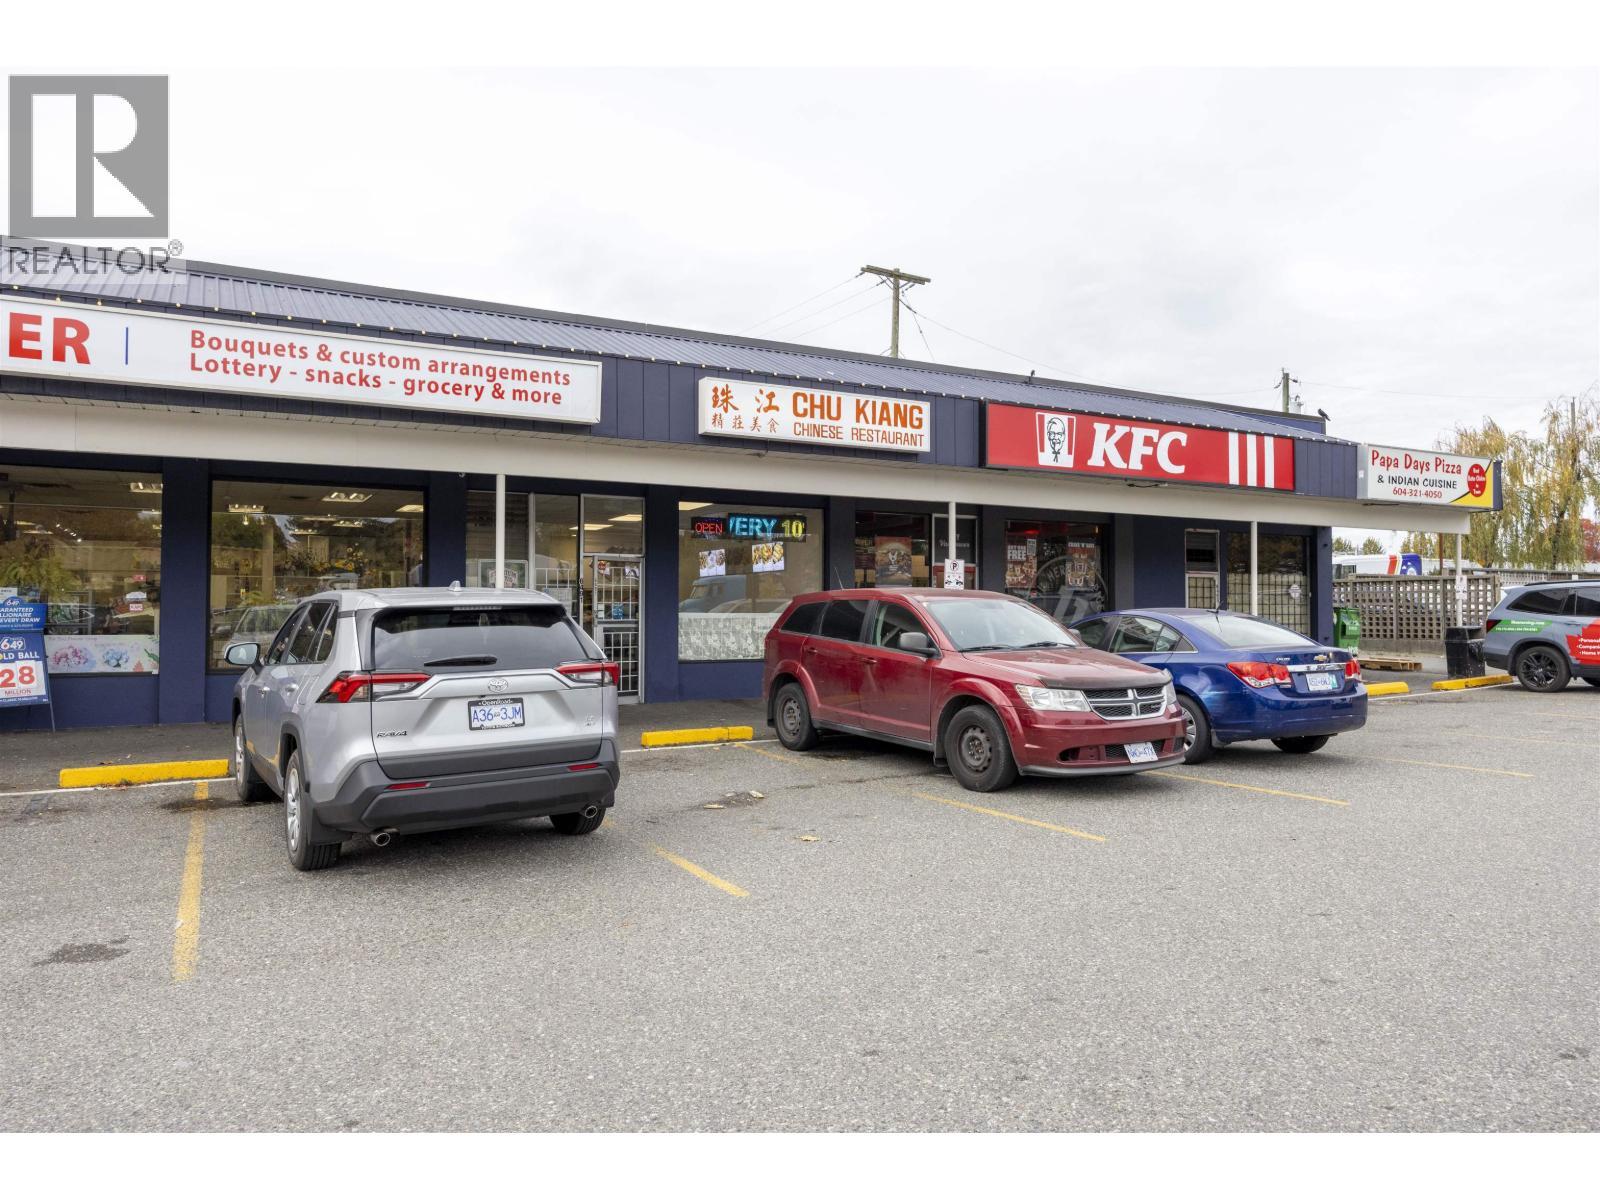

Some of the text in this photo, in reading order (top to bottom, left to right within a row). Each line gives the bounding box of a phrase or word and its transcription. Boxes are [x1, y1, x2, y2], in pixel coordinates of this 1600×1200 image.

[190, 329, 571, 386] Bouquets & custom arrangements
[190, 352, 282, 383] Lottery
[305, 366, 382, 388] snacks
[403, 376, 485, 401] grocery
[491, 382, 506, 400] &
[512, 388, 562, 405] more
[711, 383, 780, 414] 珠江
[792, 391, 923, 430] CHU KIANG
[793, 421, 925, 447] CHINESE RESTAURANT
[1086, 422, 1188, 474] KFC
[1371, 449, 1462, 475] Papa Days Pizza
[1377, 474, 1385, 484] &
[1388, 475, 1420, 487] INDIAN
[1422, 477, 1457, 489] CUISINE
[695, 522, 723, 535] OPEN
[781, 519, 805, 538] 10
[1007, 549, 1027, 561] FREE
[18, 651, 41, 660] BALL
[4, 688, 32, 696] MILLION
